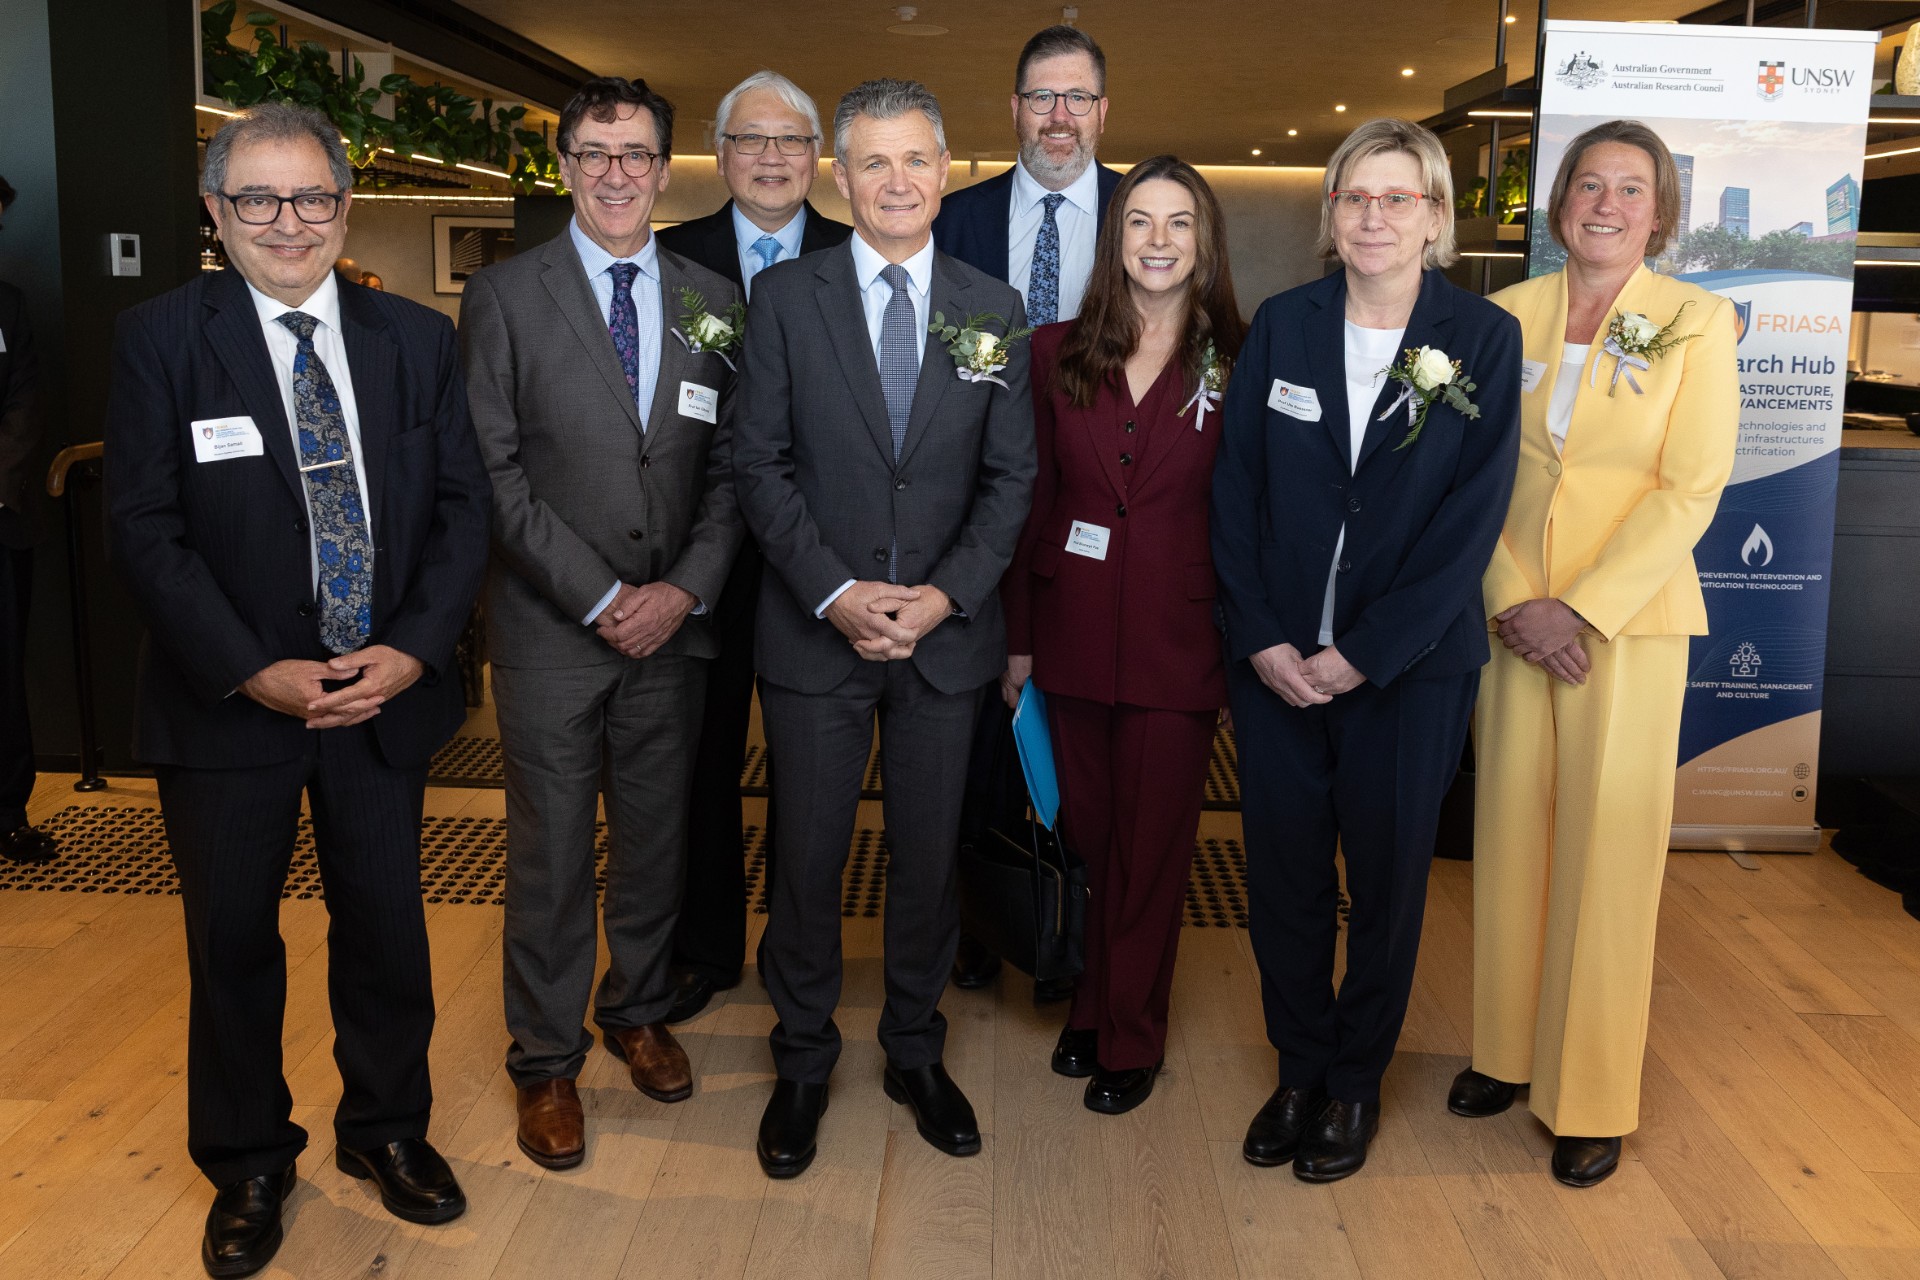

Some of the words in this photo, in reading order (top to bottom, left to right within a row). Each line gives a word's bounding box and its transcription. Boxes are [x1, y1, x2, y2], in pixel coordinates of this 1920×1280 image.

[1612, 63, 1658, 73] Australian
[1659, 64, 1712, 75] Government
[1791, 67, 1855, 87] UNSW
[1611, 79, 1654, 90] Australian
[1655, 82, 1692, 91] Research
[1693, 82, 1724, 93] Council
[1756, 313, 1842, 334] FRIASA
[1737, 354, 1783, 374] arch
[1791, 355, 1836, 375] Hub
[1740, 384, 1833, 398] ASTRUCTURE,
[1738, 421, 1804, 432] echnologies
[1806, 422, 1826, 432] and
[1744, 434, 1824, 445] infrastructures
[1735, 446, 1796, 456] ctrification
[1698, 572, 1749, 580] PREVENTION,
[1750, 573, 1805, 581] INTERVENTION
[1746, 583, 1803, 591] TECHNOLOGIES
[1691, 681, 1720, 689] SAFETY
[1721, 682, 1759, 690] TRAINING,
[1697, 766, 1788, 774] HTTPS://FRIASA.ORG.AU/
[1692, 789, 1784, 797] C.WANG@UNSW.EDU.AU
